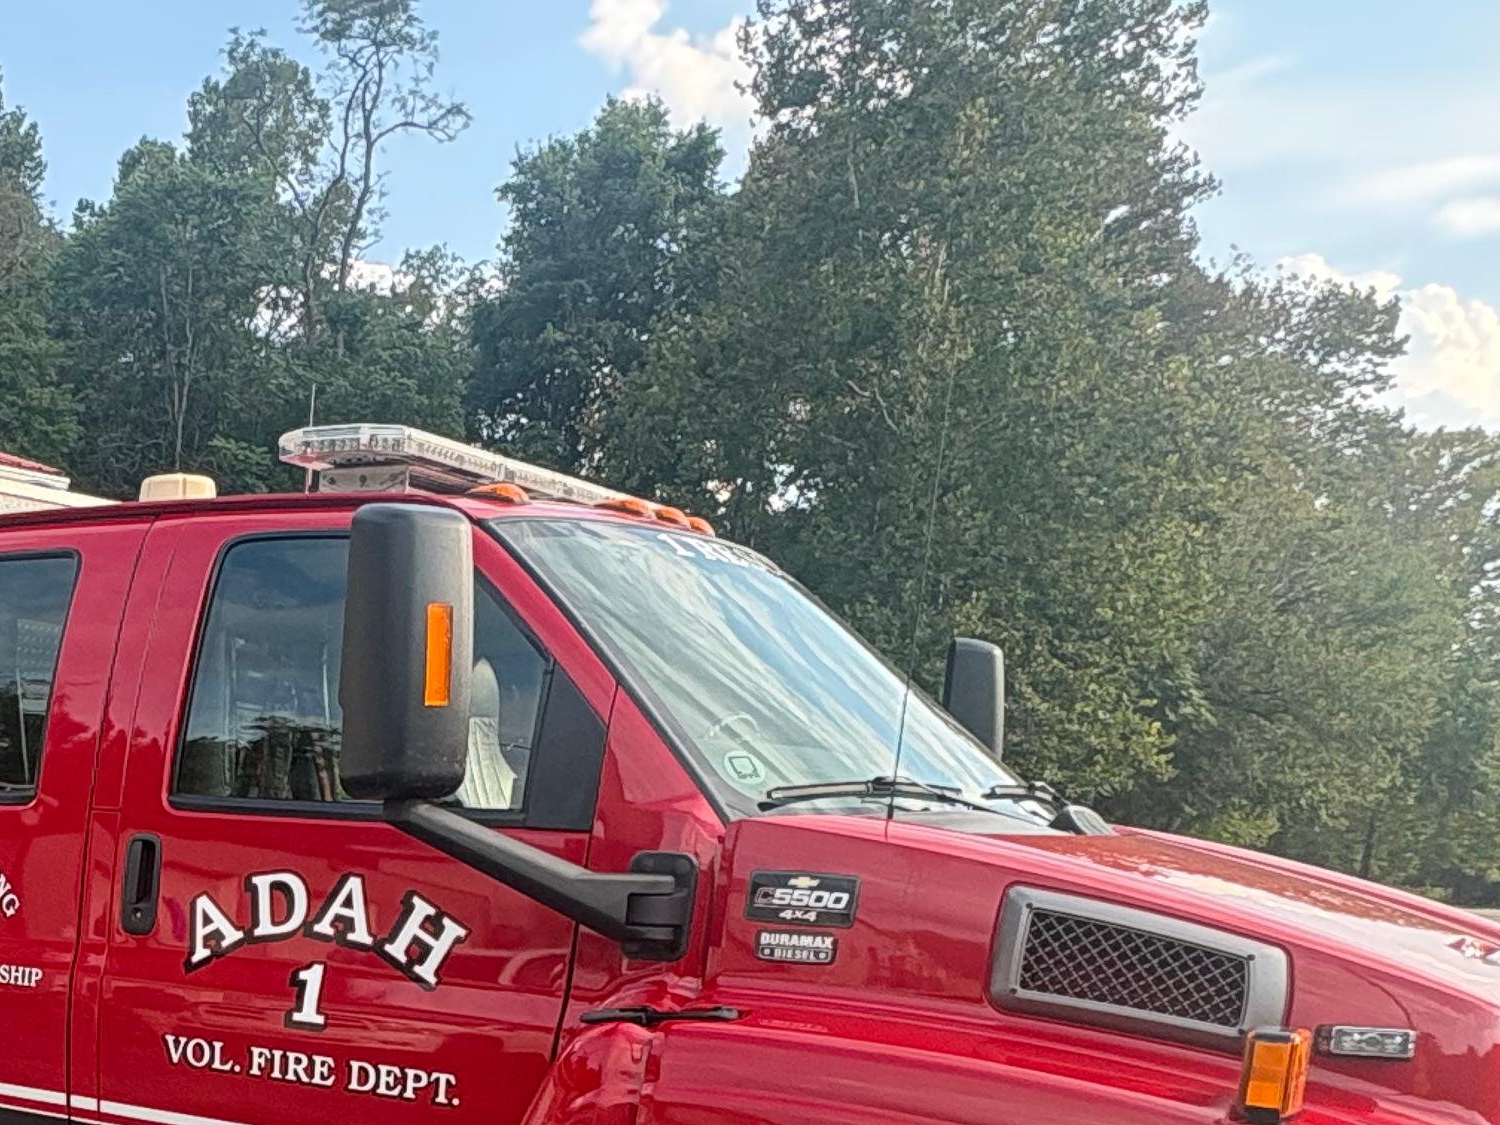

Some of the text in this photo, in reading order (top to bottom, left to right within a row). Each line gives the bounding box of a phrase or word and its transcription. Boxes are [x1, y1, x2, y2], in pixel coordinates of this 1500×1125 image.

[754, 886, 849, 909] C5500
[191, 873, 466, 985] ADAH
[760, 932, 833, 948] DURAMAX
[774, 948, 815, 960] DIESEL
[292, 964, 325, 1024] 1
[165, 1034, 460, 1106] VOL. FIRE DEPT.
